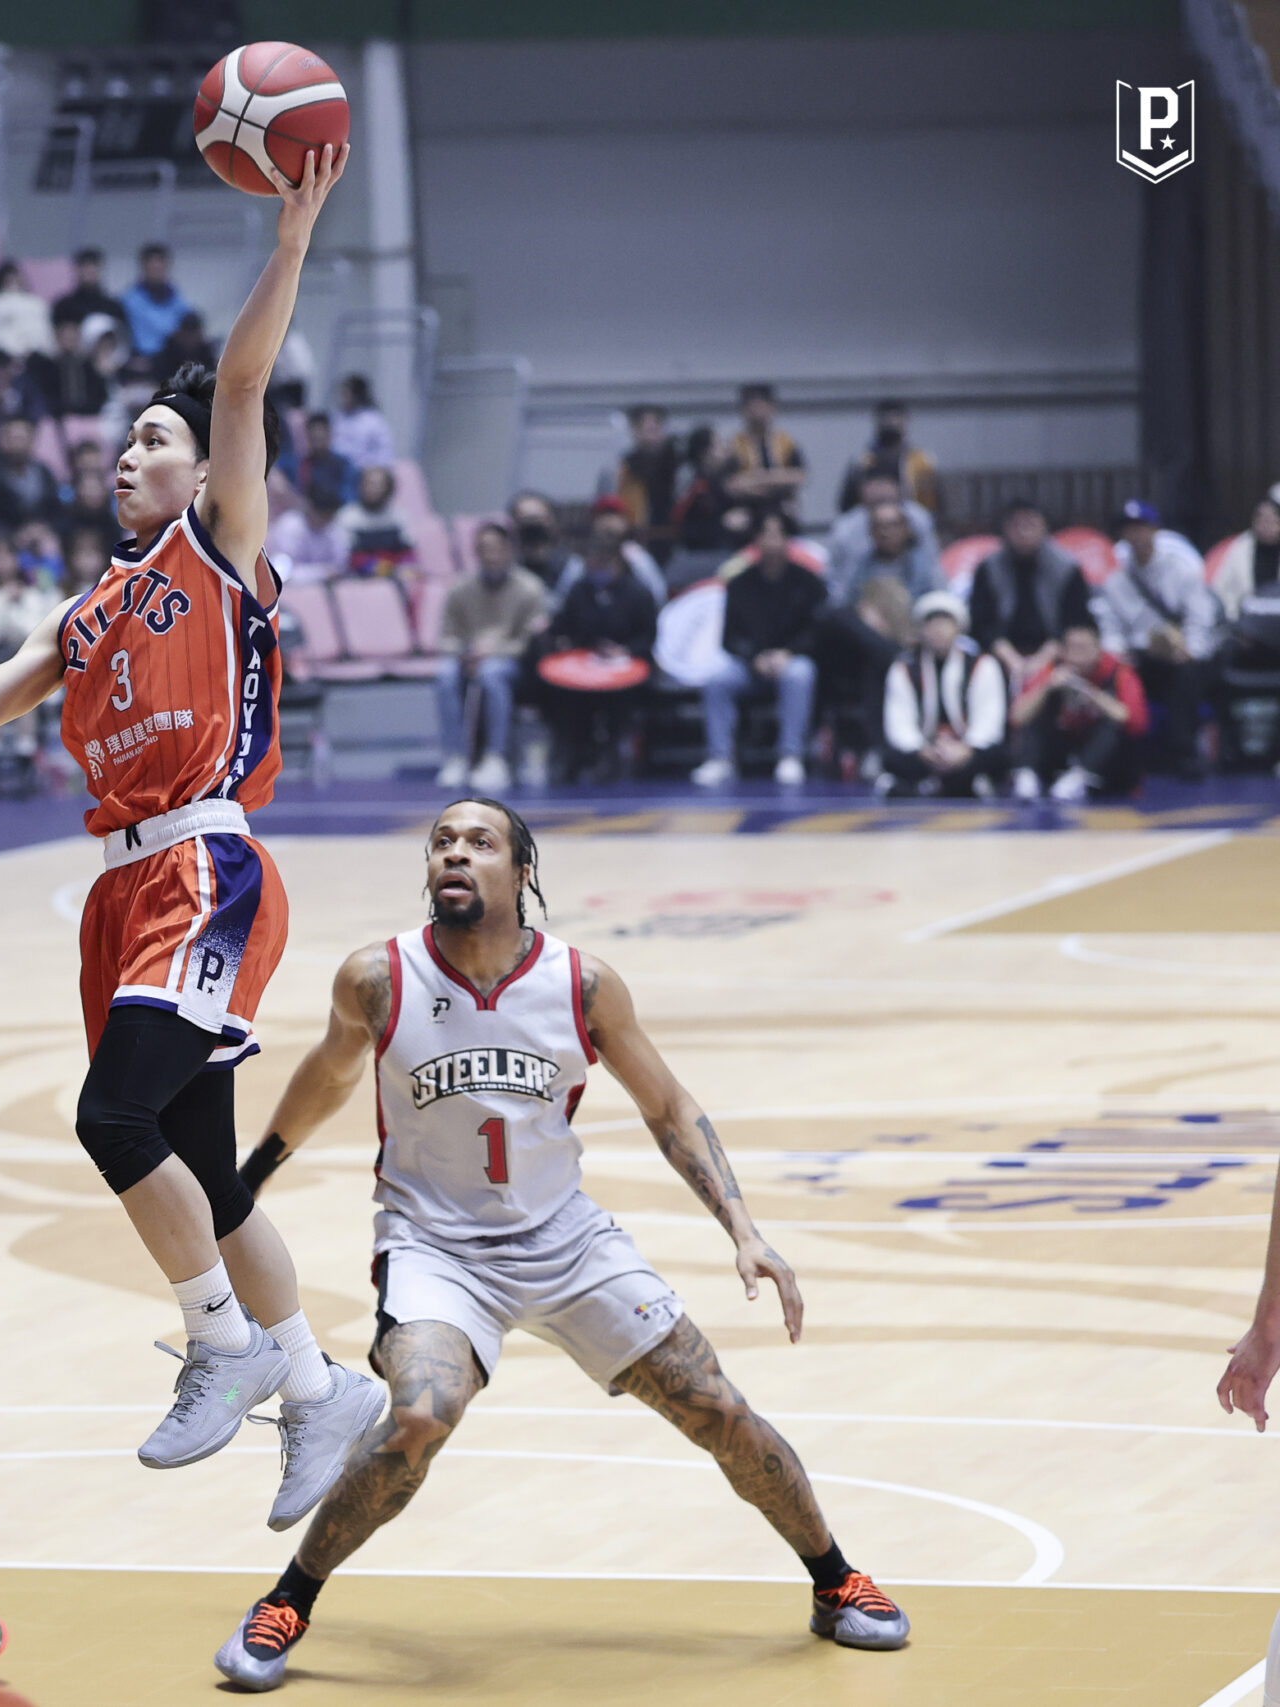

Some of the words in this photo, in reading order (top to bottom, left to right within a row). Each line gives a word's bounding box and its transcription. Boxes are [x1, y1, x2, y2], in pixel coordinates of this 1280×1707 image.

[110, 648, 133, 712] 3
[197, 947, 225, 991] P
[478, 1117, 508, 1183] 1
